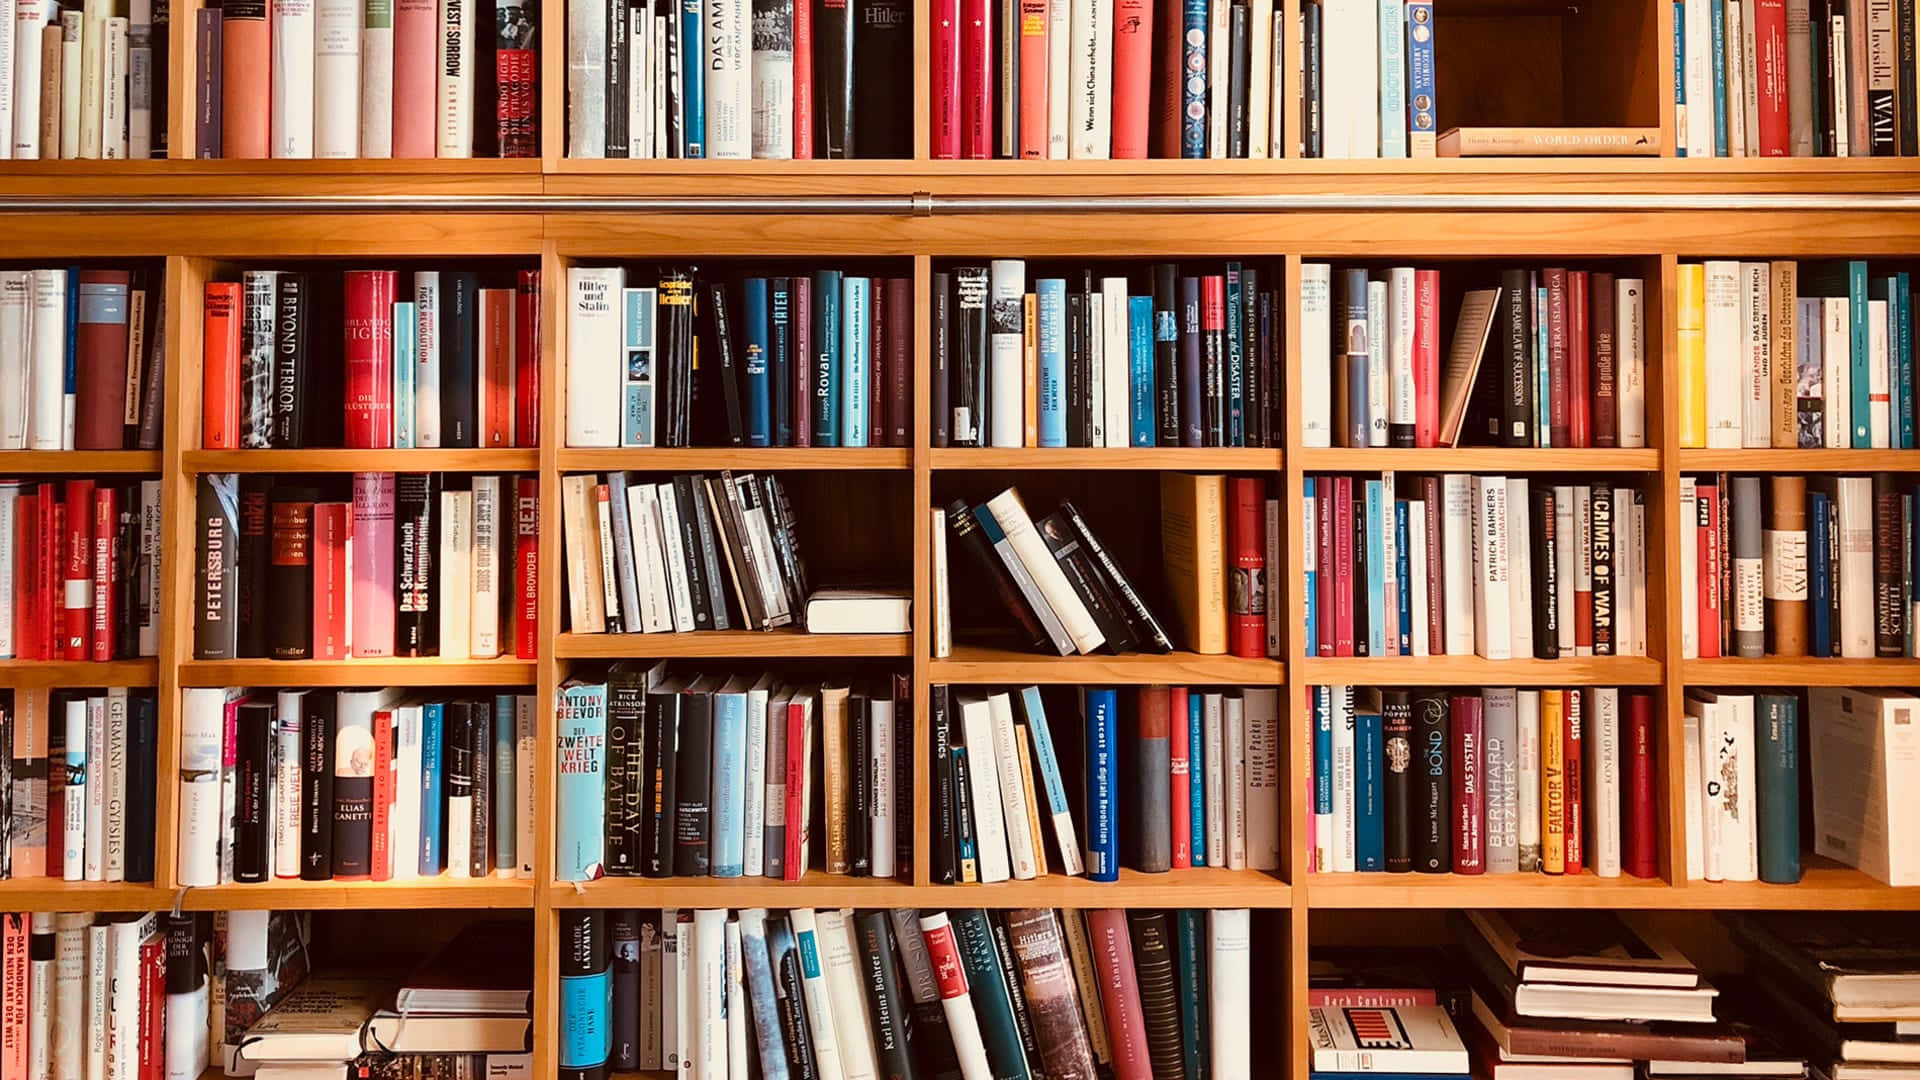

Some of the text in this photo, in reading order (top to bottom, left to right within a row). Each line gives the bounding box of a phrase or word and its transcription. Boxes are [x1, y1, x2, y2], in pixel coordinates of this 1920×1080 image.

[864, 8, 905, 25] Hitler
[446, 31, 460, 77] SORROW
[712, 36, 723, 71] DAS
[1872, 1, 1891, 86] The Invisible
[521, 53, 530, 103] VOLKES
[1088, 67, 1096, 89] China
[1088, 91, 1096, 105] sich
[1086, 106, 1095, 131] Wenn
[1534, 134, 1580, 145] WORLD
[1583, 134, 1628, 145] ORDER
[1873, 95, 1893, 144] WALL
[578, 281, 608, 291] Hitler
[578, 302, 610, 312] Stalin
[584, 292, 604, 301] und
[419, 287, 427, 364] FIGES REVOLUTION
[1229, 293, 1239, 340] Witnessing
[1420, 280, 1432, 349] Himmel auf Erden
[279, 297, 298, 413] BEYOND TERROR
[1231, 354, 1240, 399] DISASTER
[817, 353, 830, 421] Joseph Rovan
[145, 505, 153, 531] Jasper
[519, 497, 535, 536] RED
[1486, 488, 1498, 582] PATRICK BAHNERS
[1497, 488, 1507, 582] DIE PANIKMACHER
[1700, 499, 1709, 526] PIPER
[207, 518, 222, 621] PETERSBURG
[401, 522, 415, 593] Schwarzbuch
[415, 519, 430, 592] Kommunismus
[1593, 500, 1610, 628] CRIMES OF WAR
[1720, 497, 1731, 601] Confronting the Nation
[1782, 537, 1794, 594] ZWEITE
[1795, 536, 1807, 594] WELT
[400, 596, 415, 612] Das
[417, 596, 428, 611] des
[526, 551, 536, 621] BILL BROWDER
[1880, 582, 1891, 635] JONATHAN
[1890, 582, 1901, 634] SCHELL
[558, 695, 602, 708] ANTONY
[558, 708, 602, 720] BEEVOR
[1570, 690, 1580, 740] campus
[1770, 703, 1778, 740] Ernst Klee
[109, 702, 123, 770] GERMANY
[317, 718, 325, 772] NACH ABSCHIED
[377, 740, 385, 767] TASTE
[558, 736, 603, 748] ZWEITE
[565, 748, 597, 761] WELT
[573, 727, 588, 737] DER
[938, 723, 949, 760] Tories
[1249, 719, 1263, 788] George Packer
[1265, 719, 1277, 788] Die Abwicklung
[1603, 695, 1614, 784] KONRAD LORENZ
[377, 771, 385, 786] OF
[560, 761, 598, 773] KRIEG
[609, 726, 625, 846] OF BATTLE
[624, 739, 640, 836] THE DAY
[1095, 704, 1108, 844] Tapscott Die digitale Revolution
[1463, 733, 1473, 794] DAS SYSTEM
[289, 765, 301, 828] FREIE WELT
[340, 804, 366, 812] ELIAS
[376, 790, 385, 826] ASHES
[1430, 781, 1439, 843] Lynne McTaggart
[1487, 738, 1502, 847] BERNHARD
[1504, 761, 1517, 846] GRZIMEK
[1547, 768, 1561, 834] FAKTOR V
[109, 799, 120, 854] GYPSIES
[96, 932, 104, 976] Mediapolis
[582, 916, 591, 969] LANZMANN
[965, 920, 983, 971] SENIOR
[972, 914, 993, 972] SERVICE
[1019, 930, 1053, 946] Hitlers
[6, 954, 14, 1003] NEUSTART
[16, 936, 25, 1025] DAS HANDBUCH FÜR
[871, 955, 886, 991] Bohrer
[6, 1004, 14, 1023] DER
[95, 981, 104, 1027] Silverstone
[577, 989, 587, 1057] PATAGONISCHE
[786, 956, 811, 1079] Wut eines Kindes, Zorn eines Lebens
[878, 994, 891, 1024] Heinz
[1324, 995, 1416, 1006] Dark Continent
[5, 1024, 13, 1049] WELT
[881, 1026, 895, 1050] Karl
